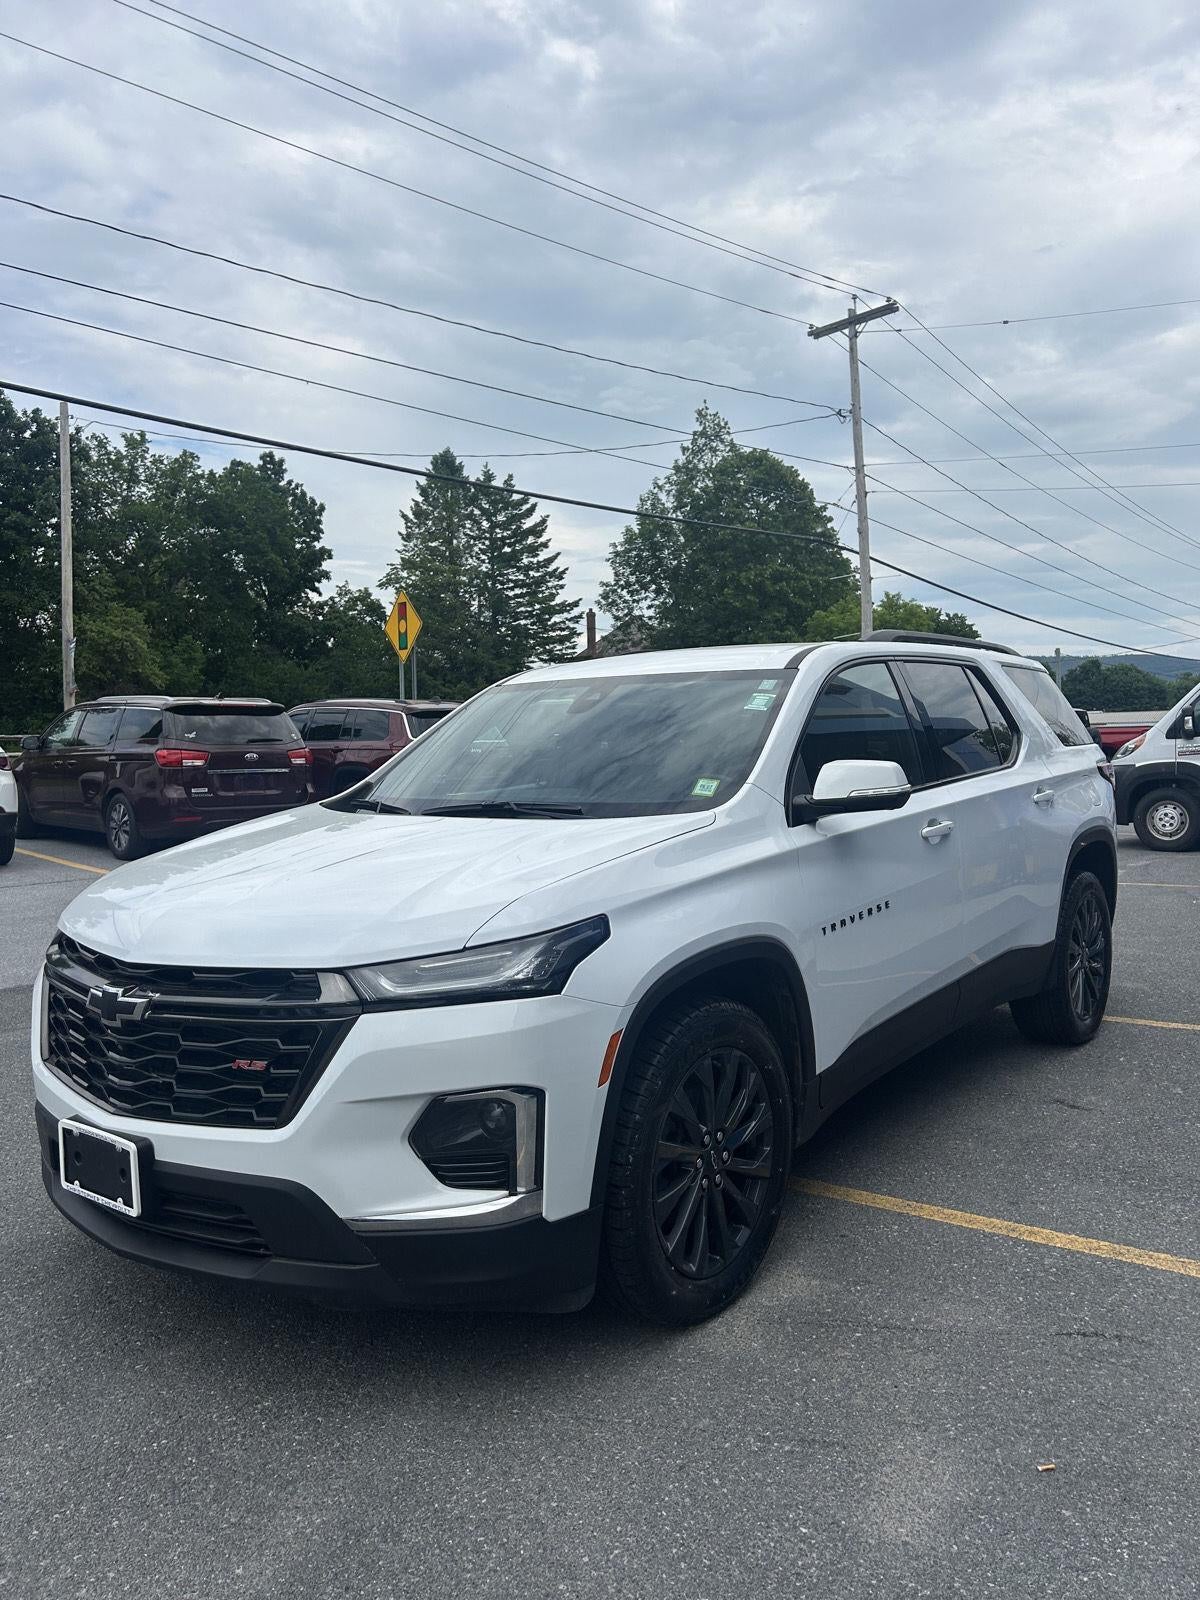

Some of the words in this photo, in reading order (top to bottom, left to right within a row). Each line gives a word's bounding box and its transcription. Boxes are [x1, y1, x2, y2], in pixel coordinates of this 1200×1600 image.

[821, 900, 890, 936] TRAVERSE
[232, 1059, 268, 1070] RS
[100, 1198, 131, 1215] CHEVROLET
